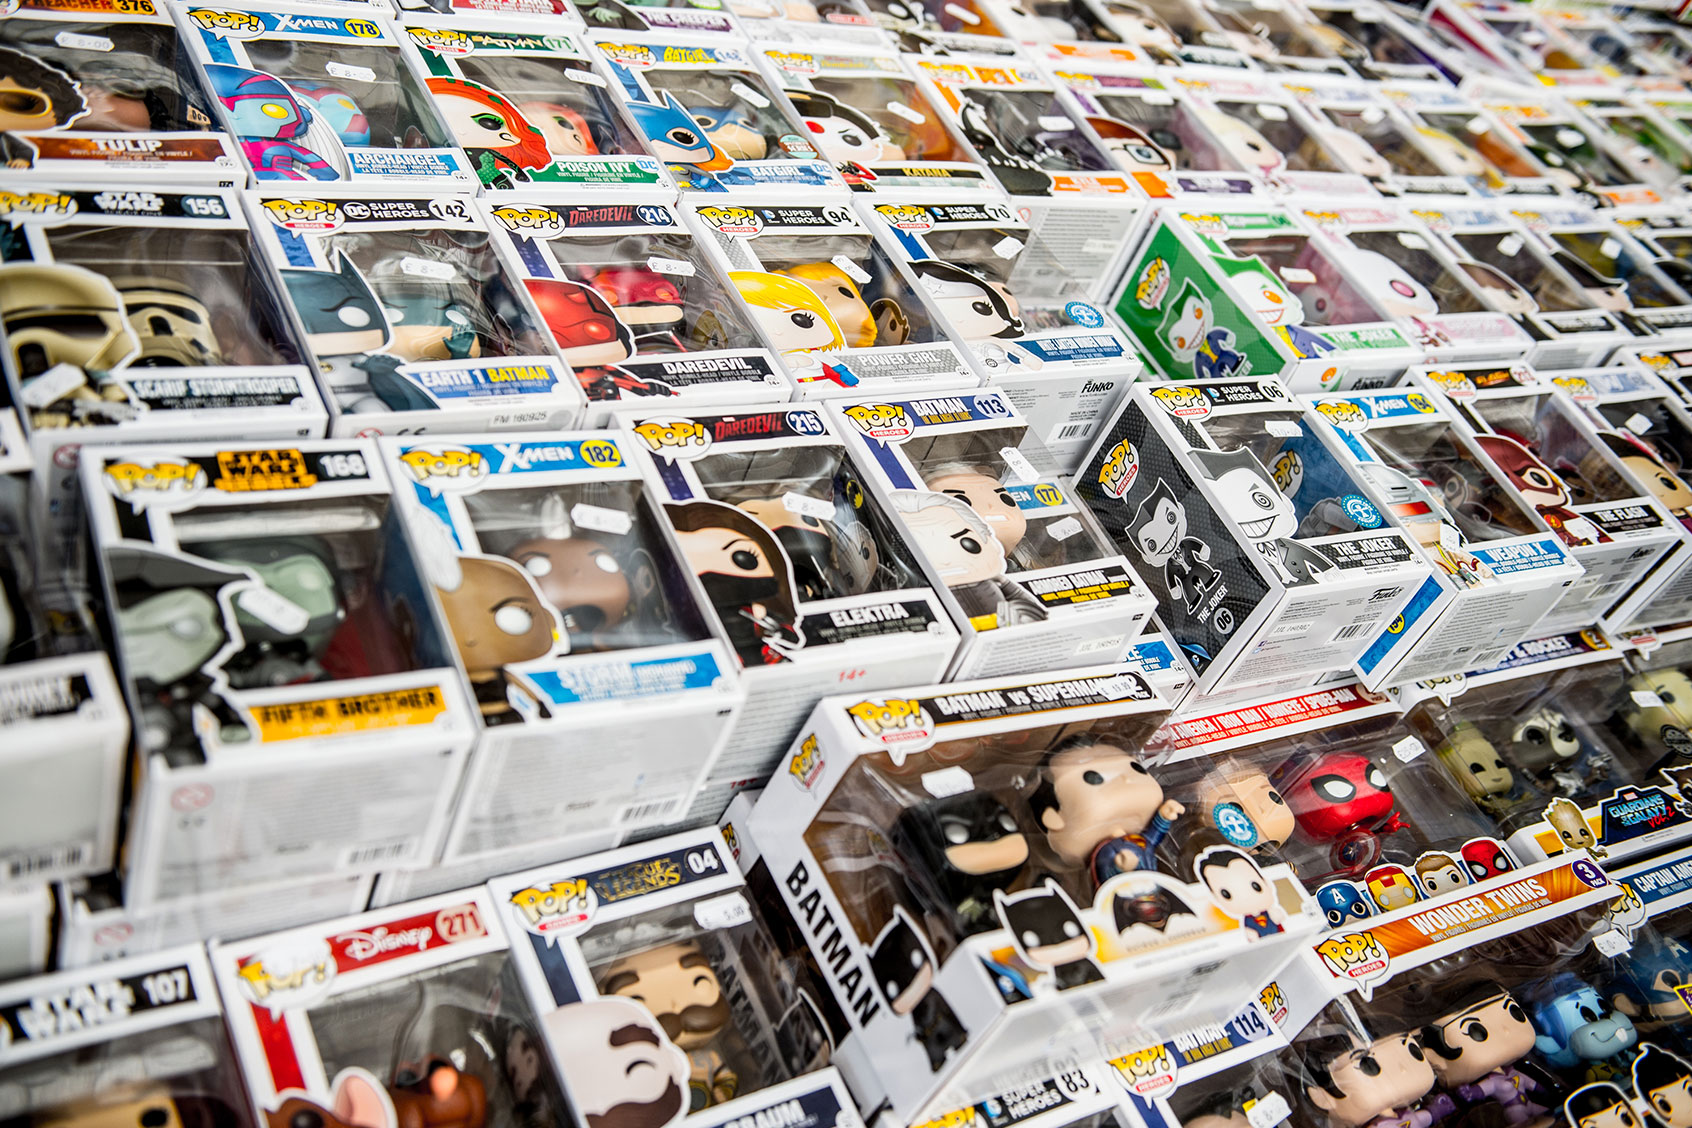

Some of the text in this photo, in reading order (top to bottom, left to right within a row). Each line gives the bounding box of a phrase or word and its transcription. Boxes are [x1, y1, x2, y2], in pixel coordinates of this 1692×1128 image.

[118, 0, 153, 13] 376
[187, 9, 260, 32] POP!
[346, 22, 377, 38] 178
[404, 27, 468, 50] POP!
[596, 43, 649, 61] POP!
[664, 46, 717, 64] BATGIRL
[92, 139, 163, 152] TULIP
[353, 152, 446, 166] ARCHANGEL
[556, 161, 631, 173] POISON IVY
[753, 166, 804, 176] BATGIRL
[902, 168, 952, 178] KATANA
[185, 198, 220, 215] 156
[260, 199, 338, 221] POP!
[345, 203, 369, 218] DC
[370, 202, 469, 220] SUPER 142
[370, 209, 429, 219] HEROES
[569, 207, 672, 226] DAREDEVIL 214
[827, 209, 851, 223] 94
[875, 205, 926, 229] POP!
[944, 207, 1012, 221] SUPER 70
[949, 212, 989, 222] HEROES
[493, 209, 560, 235] POP!
[696, 207, 757, 229] POP!
[787, 216, 826, 224] HEROES
[662, 357, 753, 376] DAREDEVIL
[856, 352, 909, 368] POWER
[908, 350, 942, 364] GIRL
[419, 365, 549, 387] EARTH 1 BATMAN
[1081, 381, 1114, 394] FUNKO
[1220, 383, 1283, 400] SUPER 06
[1225, 391, 1264, 402] HEROES
[910, 397, 969, 418] BATMAN
[976, 398, 1006, 417] 113
[1151, 387, 1205, 411] POP!
[843, 405, 907, 431] POP!
[1315, 399, 1361, 424] POP!
[633, 421, 706, 451] POP!
[715, 411, 822, 440] DAREDEVIL 215
[583, 444, 620, 464] 182
[400, 450, 483, 482] POP!
[1098, 437, 1135, 494] POP!
[103, 463, 203, 494] POP!
[1117, 464, 1138, 497] HEROES
[1035, 486, 1061, 503] 177
[1594, 505, 1649, 523] THE FLASH
[1331, 537, 1397, 557] THE JOKER
[1484, 542, 1549, 563] WEAPON X
[1197, 582, 1230, 626] THE JOKER
[829, 605, 911, 628] ELEKTRA
[1216, 610, 1232, 632] 06
[934, 690, 1007, 716] BATMAN
[1027, 678, 1106, 704] SUPERMA
[846, 700, 925, 737] POP!
[1177, 688, 1357, 740] AMERICA IRON MAN HAWKEYE SPIDER-MAN
[788, 733, 821, 786] POP!
[1608, 794, 1665, 818] GUARDIANS
[1627, 804, 1667, 826] GALAXY
[1665, 805, 1676, 818] 2
[688, 849, 719, 875] 04
[1577, 863, 1596, 880] 3
[1590, 878, 1606, 888] PACK
[1633, 867, 1679, 893] CAPTAIN
[510, 878, 588, 920] POP!
[1407, 878, 1549, 937] WONDER TWINS
[447, 910, 481, 937] 271
[785, 859, 881, 1029] BATMAN
[1316, 931, 1382, 973] POP!
[1349, 960, 1386, 977] HEROES
[142, 967, 188, 1006] 107
[1235, 1010, 1266, 1037] 114
[1006, 1088, 1063, 1121] HEROES
